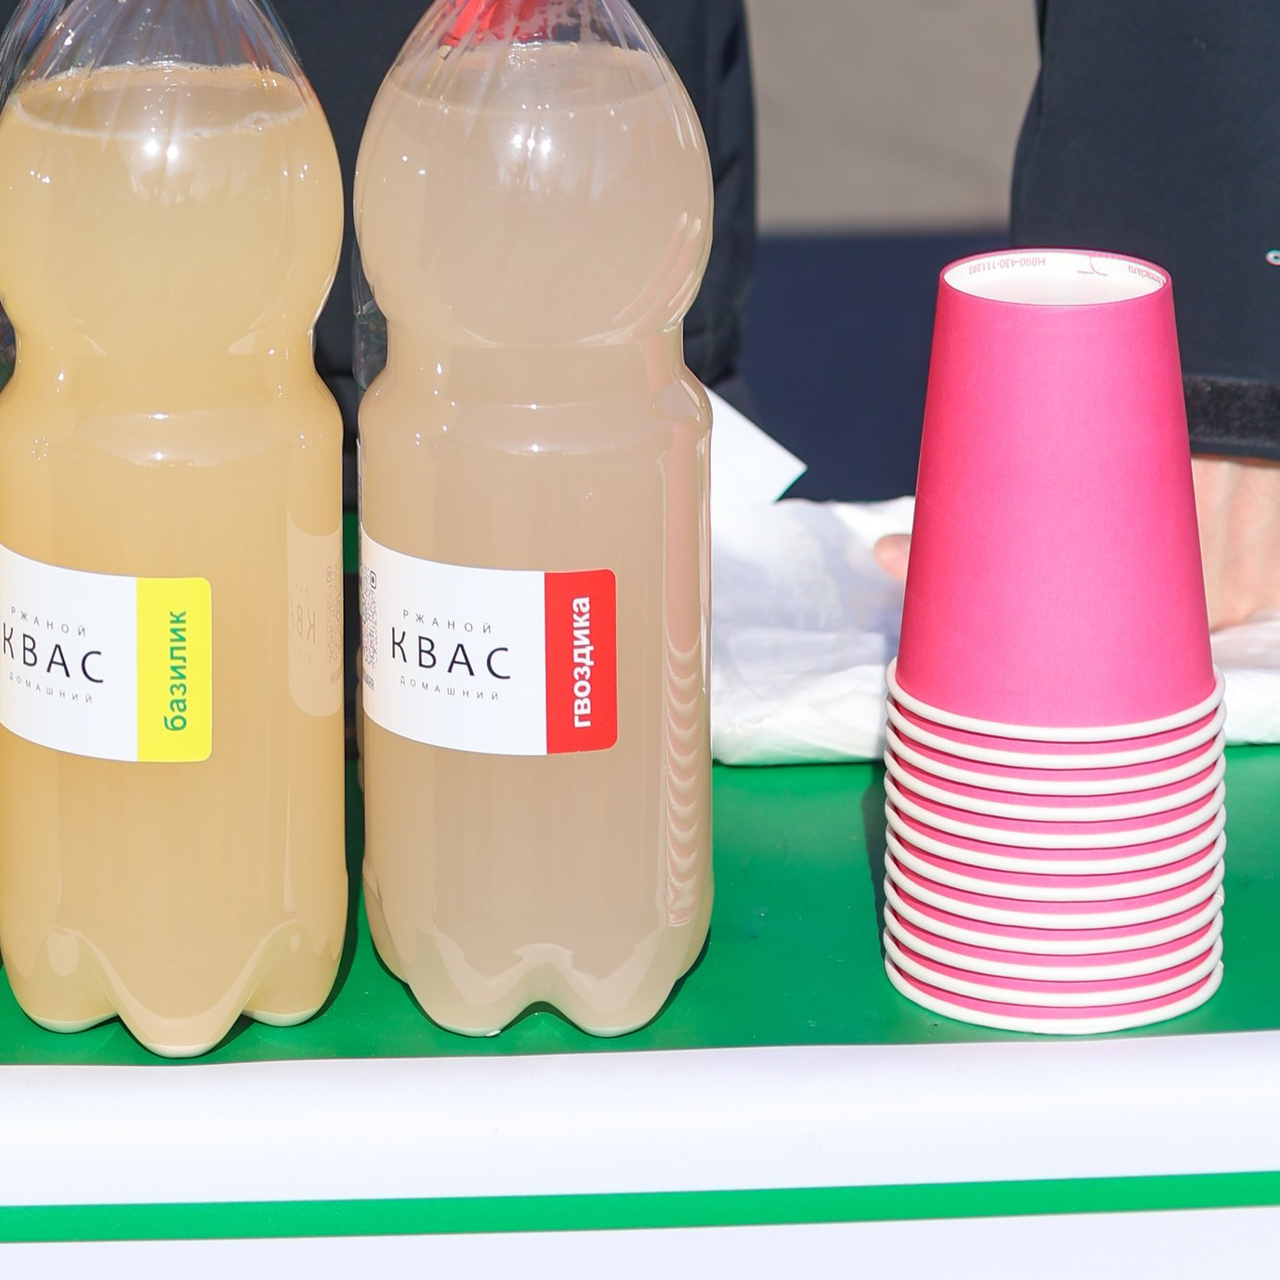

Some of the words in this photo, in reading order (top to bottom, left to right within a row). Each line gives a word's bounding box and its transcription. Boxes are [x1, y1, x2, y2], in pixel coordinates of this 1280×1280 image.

[11, 606, 86, 637] РЖАНОЙ
[403, 609, 492, 635] РЖАНОЙ
[3, 622, 104, 683] КВАС
[163, 610, 187, 732] базилик
[391, 627, 511, 680] КВАС
[572, 596, 595, 729] гвоздика
[9, 671, 93, 704] ДОМАШНИЙ
[400, 676, 499, 700] ДОМАШНИЙ
